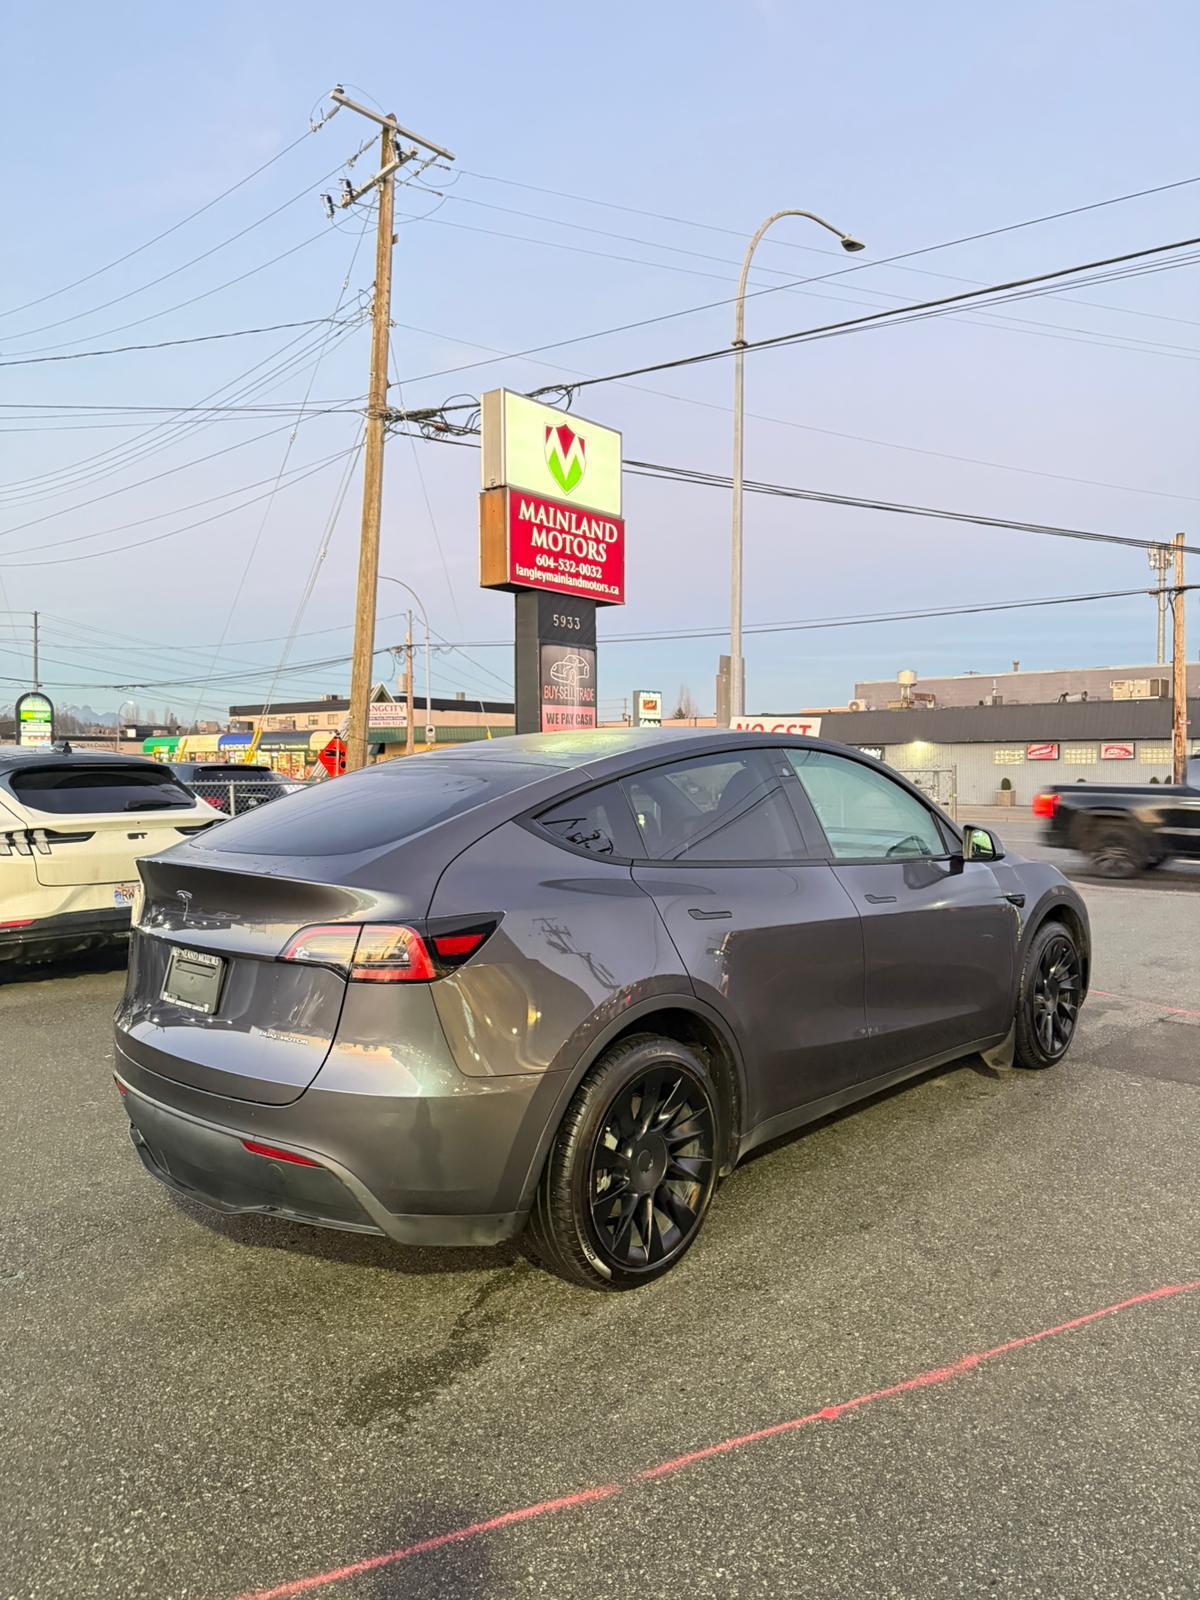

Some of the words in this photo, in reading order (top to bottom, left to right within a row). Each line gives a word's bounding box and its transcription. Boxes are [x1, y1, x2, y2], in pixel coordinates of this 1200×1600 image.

[518, 499, 618, 543] MAINLAND
[531, 525, 607, 562] MOTORS
[516, 563, 620, 595] langleymainlandmotors.ca
[535, 553, 603, 579] 604-532-0032
[553, 614, 581, 630] 5933
[546, 712, 559, 724] WE
[561, 712, 575, 725] PAY
[576, 713, 592, 726] CASH
